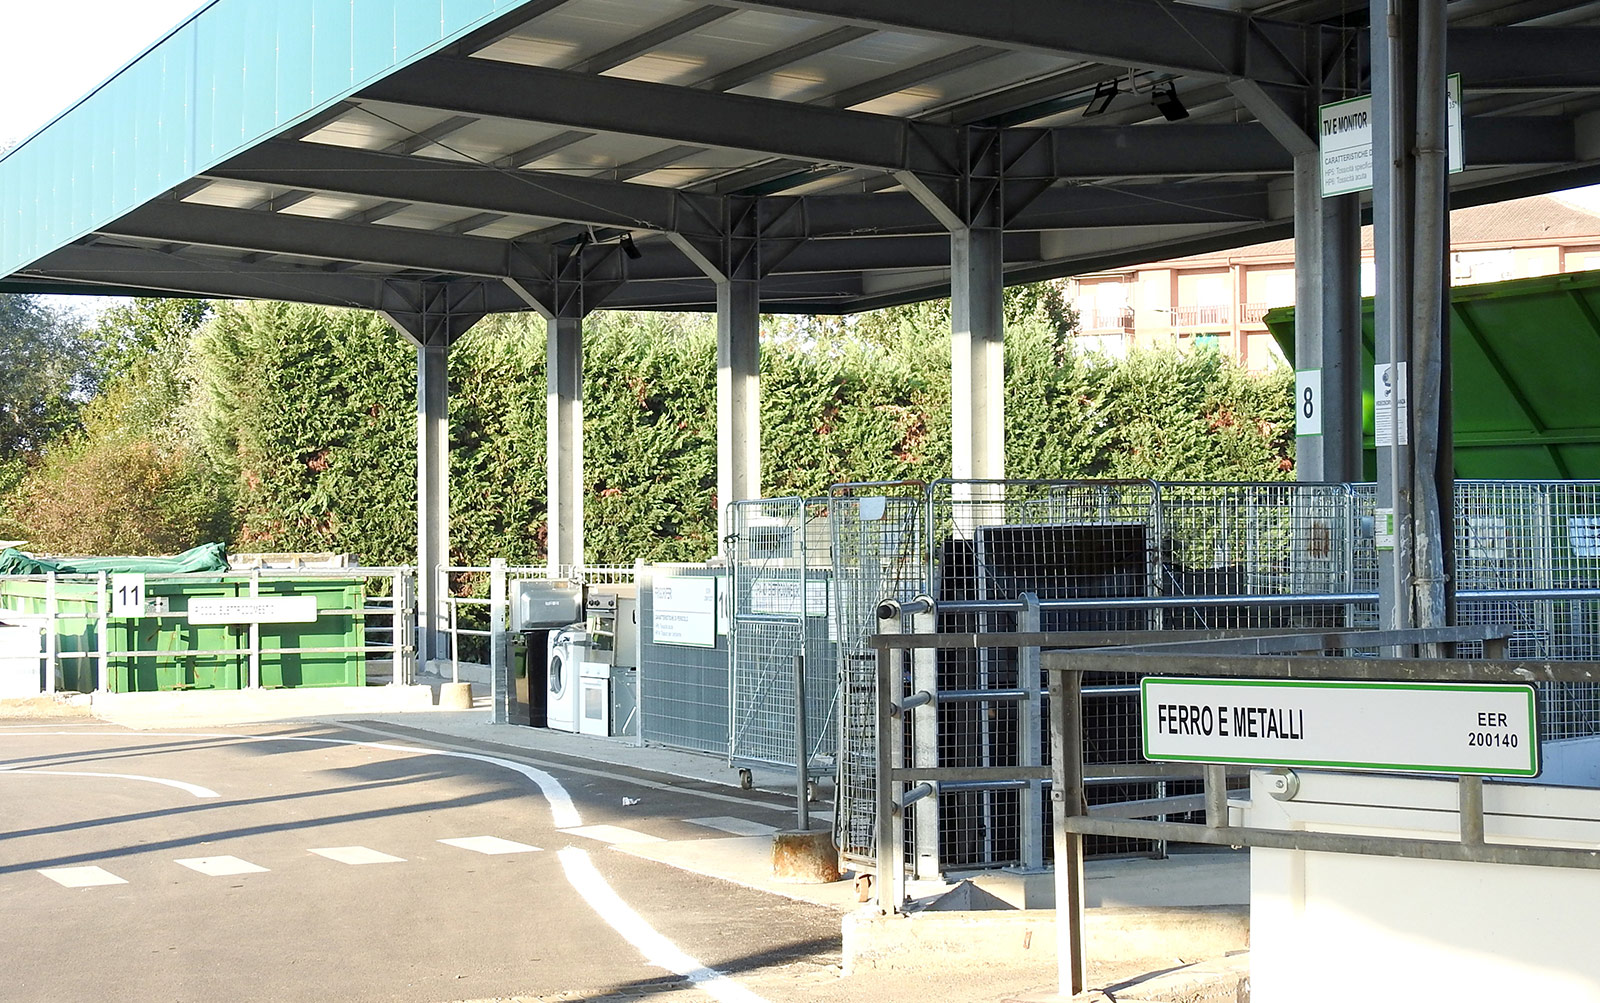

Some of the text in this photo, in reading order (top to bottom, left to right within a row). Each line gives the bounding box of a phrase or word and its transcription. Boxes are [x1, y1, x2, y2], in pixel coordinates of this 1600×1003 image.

[1323, 111, 1367, 136] TV E MONITOR
[1325, 149, 1368, 165] CARATTERISTICHE
[1304, 387, 1313, 418] 8
[119, 585, 140, 606] 11
[1158, 704, 1304, 740] FERRO E METALLI
[1478, 712, 1508, 727] EER
[1468, 732, 1518, 748] 200140
